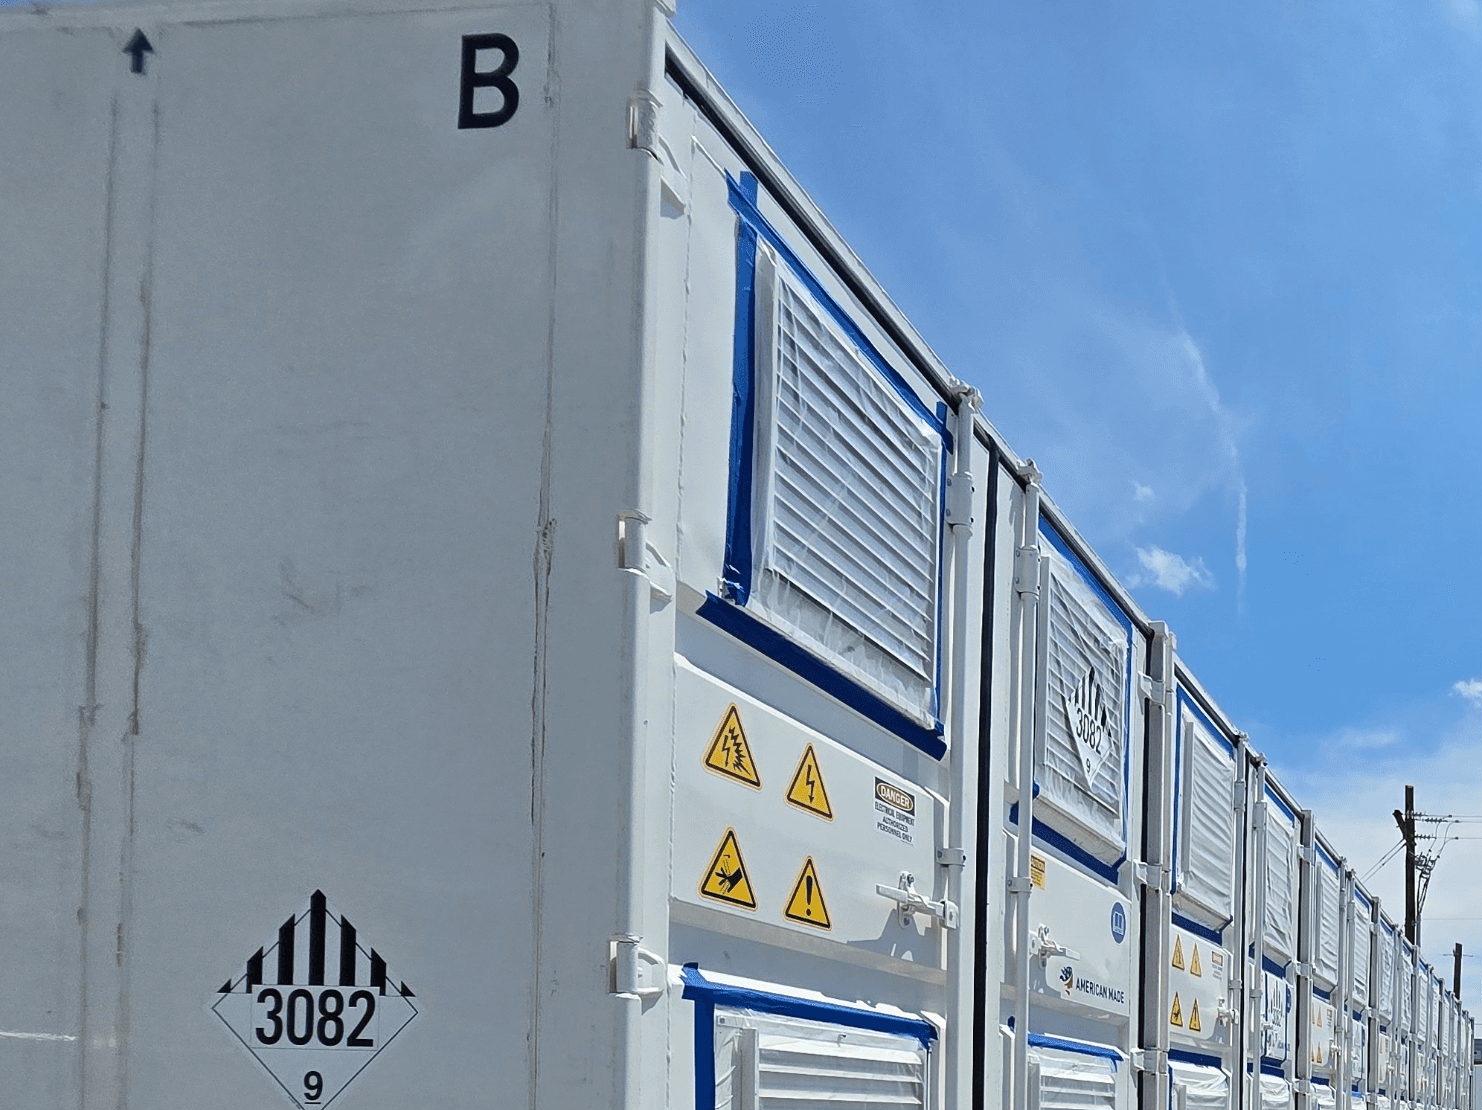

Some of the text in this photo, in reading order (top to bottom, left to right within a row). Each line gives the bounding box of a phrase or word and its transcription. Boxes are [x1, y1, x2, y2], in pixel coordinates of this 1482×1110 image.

[458, 33, 520, 130] B
[1076, 707, 1102, 756] 3082
[1086, 758, 1091, 774] 9
[880, 785, 910, 809] DANGER
[877, 822, 913, 843] PERSONNEL ONLY
[1075, 977, 1125, 1004] AMERICAN MADE
[255, 988, 376, 1048] 3082
[303, 1071, 324, 1101] 9
